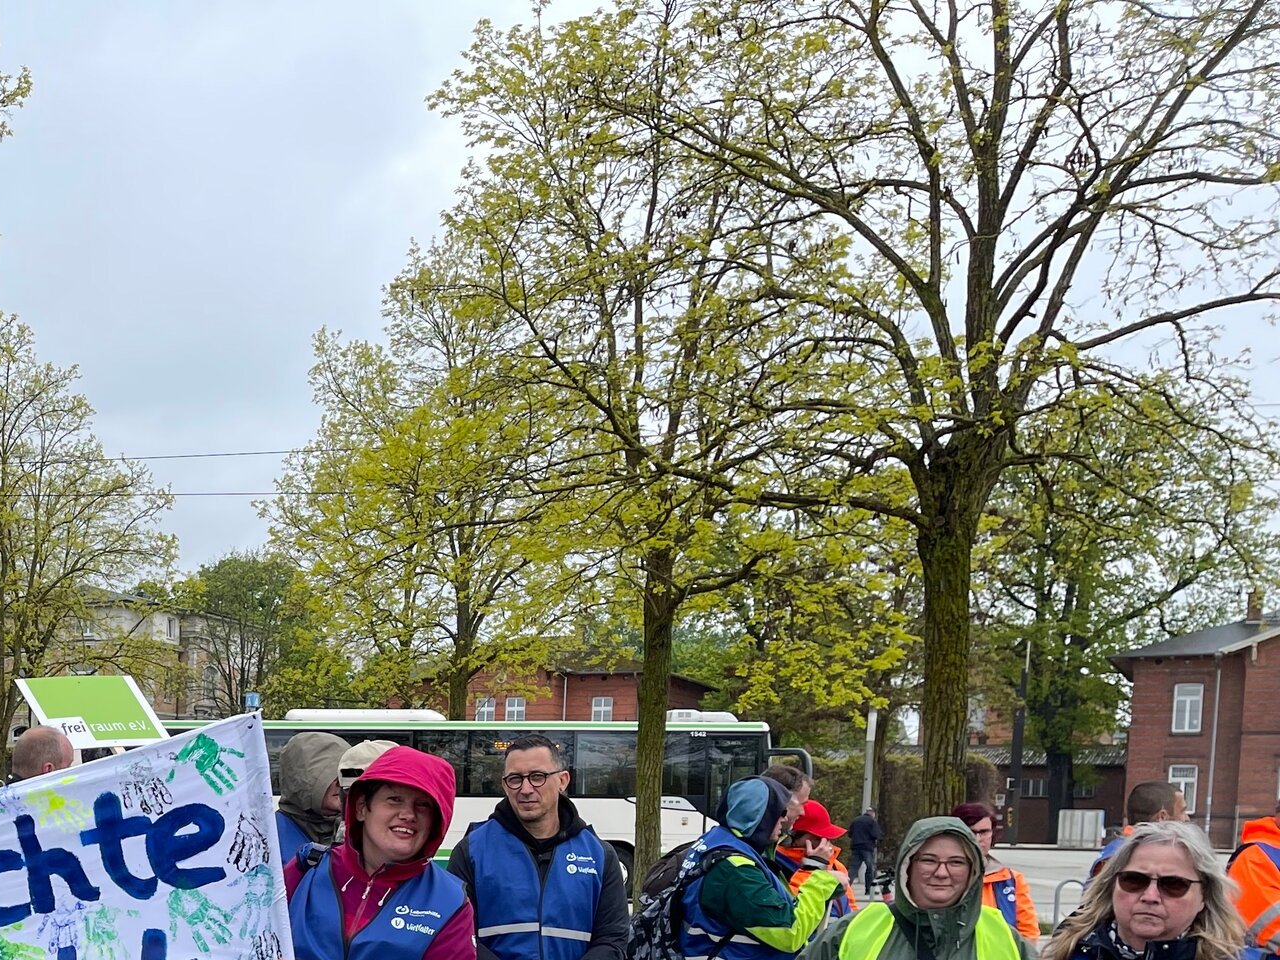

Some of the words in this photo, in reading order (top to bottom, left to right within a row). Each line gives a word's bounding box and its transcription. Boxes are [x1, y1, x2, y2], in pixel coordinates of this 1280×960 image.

[61, 720, 87, 736] frei
[90, 722, 126, 733] raum
[129, 720, 151, 732] e.V.
